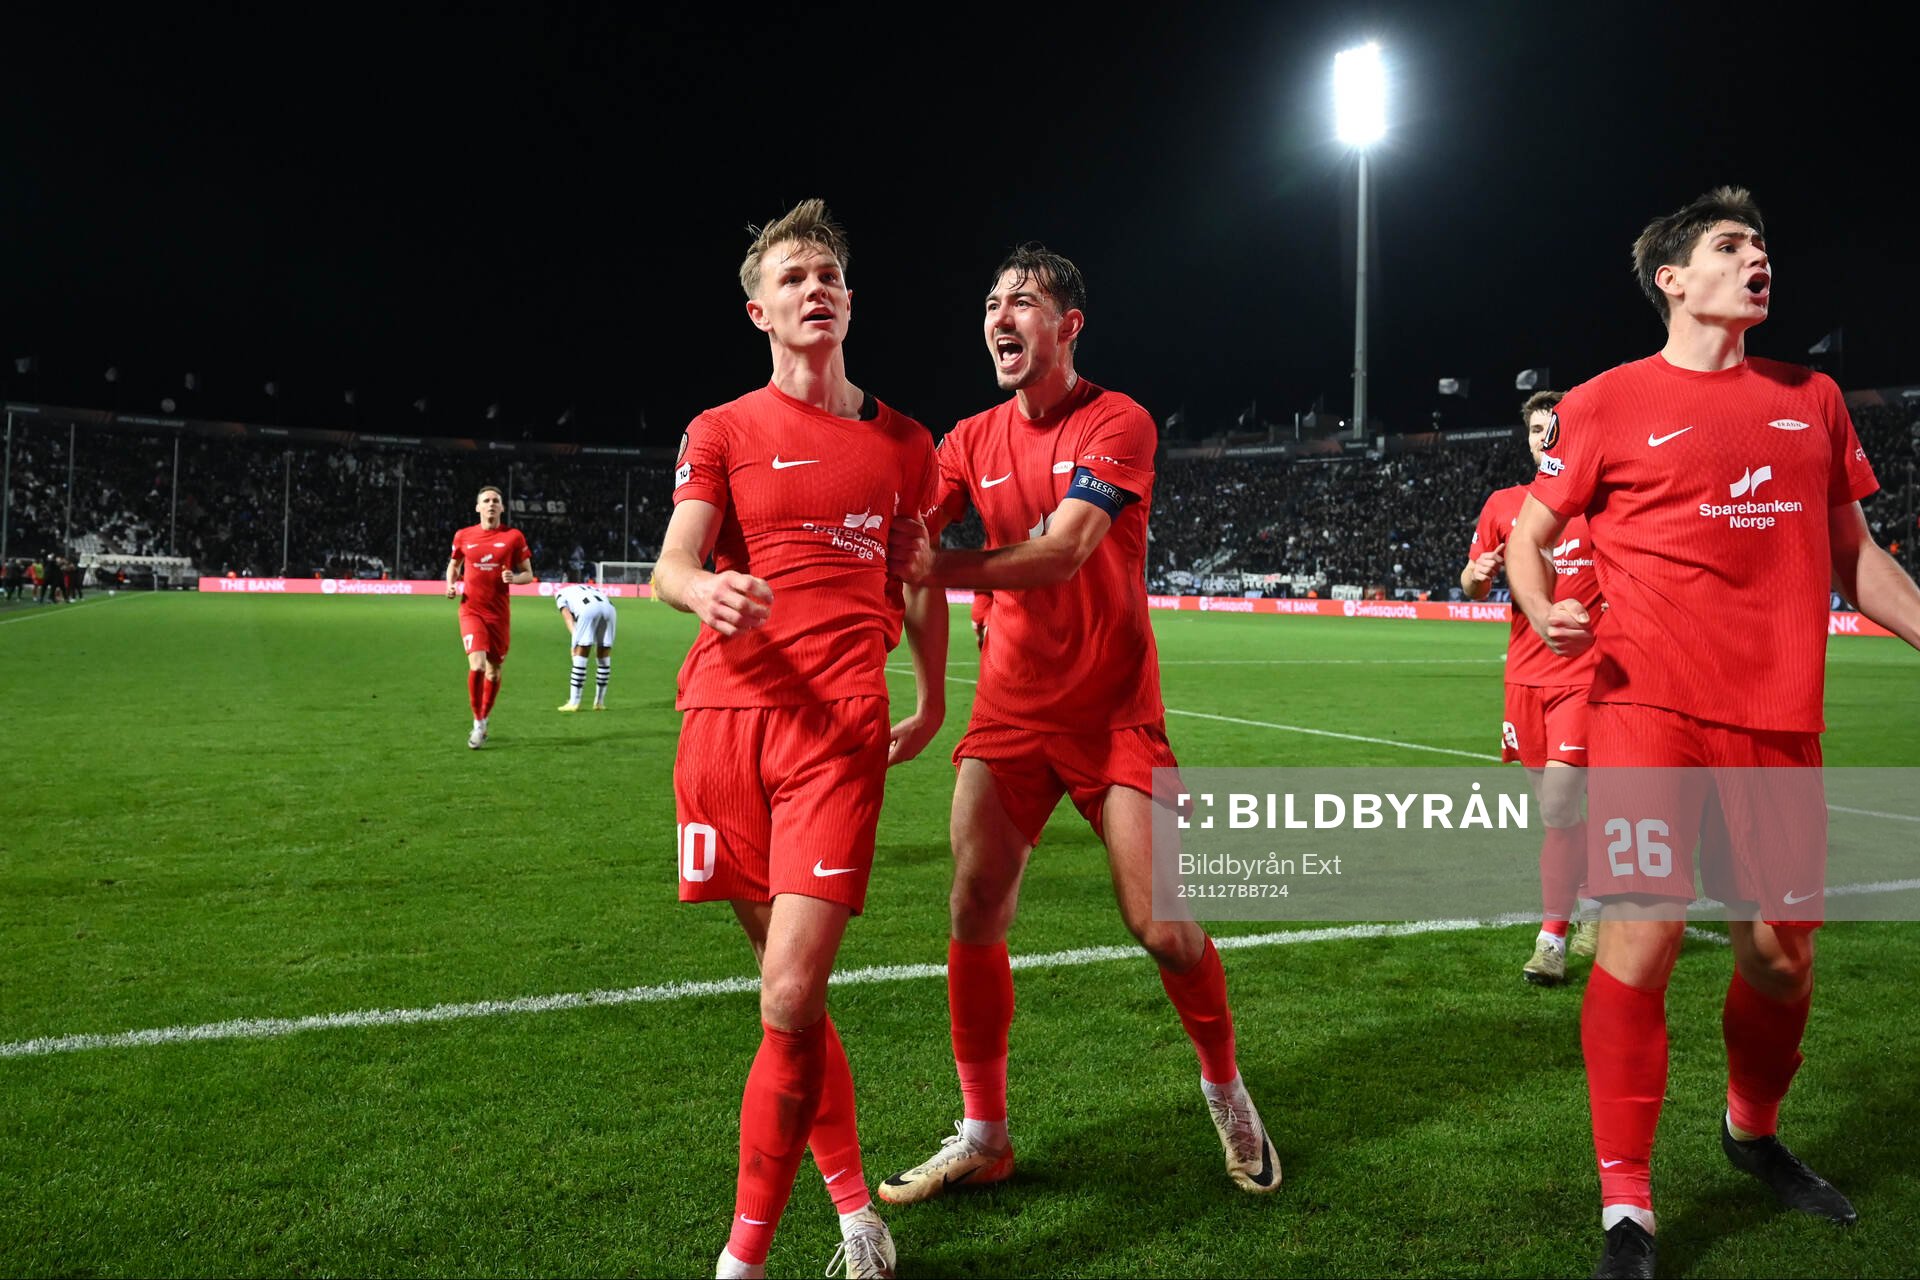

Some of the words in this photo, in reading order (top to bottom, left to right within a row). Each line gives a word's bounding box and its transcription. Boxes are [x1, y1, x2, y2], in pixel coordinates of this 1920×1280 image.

[1699, 500, 1803, 518] Sparebanken
[1729, 515, 1776, 530] Norge
[831, 536, 873, 560] Norge
[1553, 557, 1595, 567] rebanken
[219, 579, 245, 591] THE
[248, 579, 286, 591] BANK
[338, 579, 412, 594] Swissquote
[1294, 602, 1319, 613] BANK
[1356, 601, 1416, 618] Swissquote
[1448, 605, 1469, 619] THE
[1472, 606, 1505, 620] BANK
[1829, 616, 1860, 633] NK
[1604, 817, 1672, 878] 26
